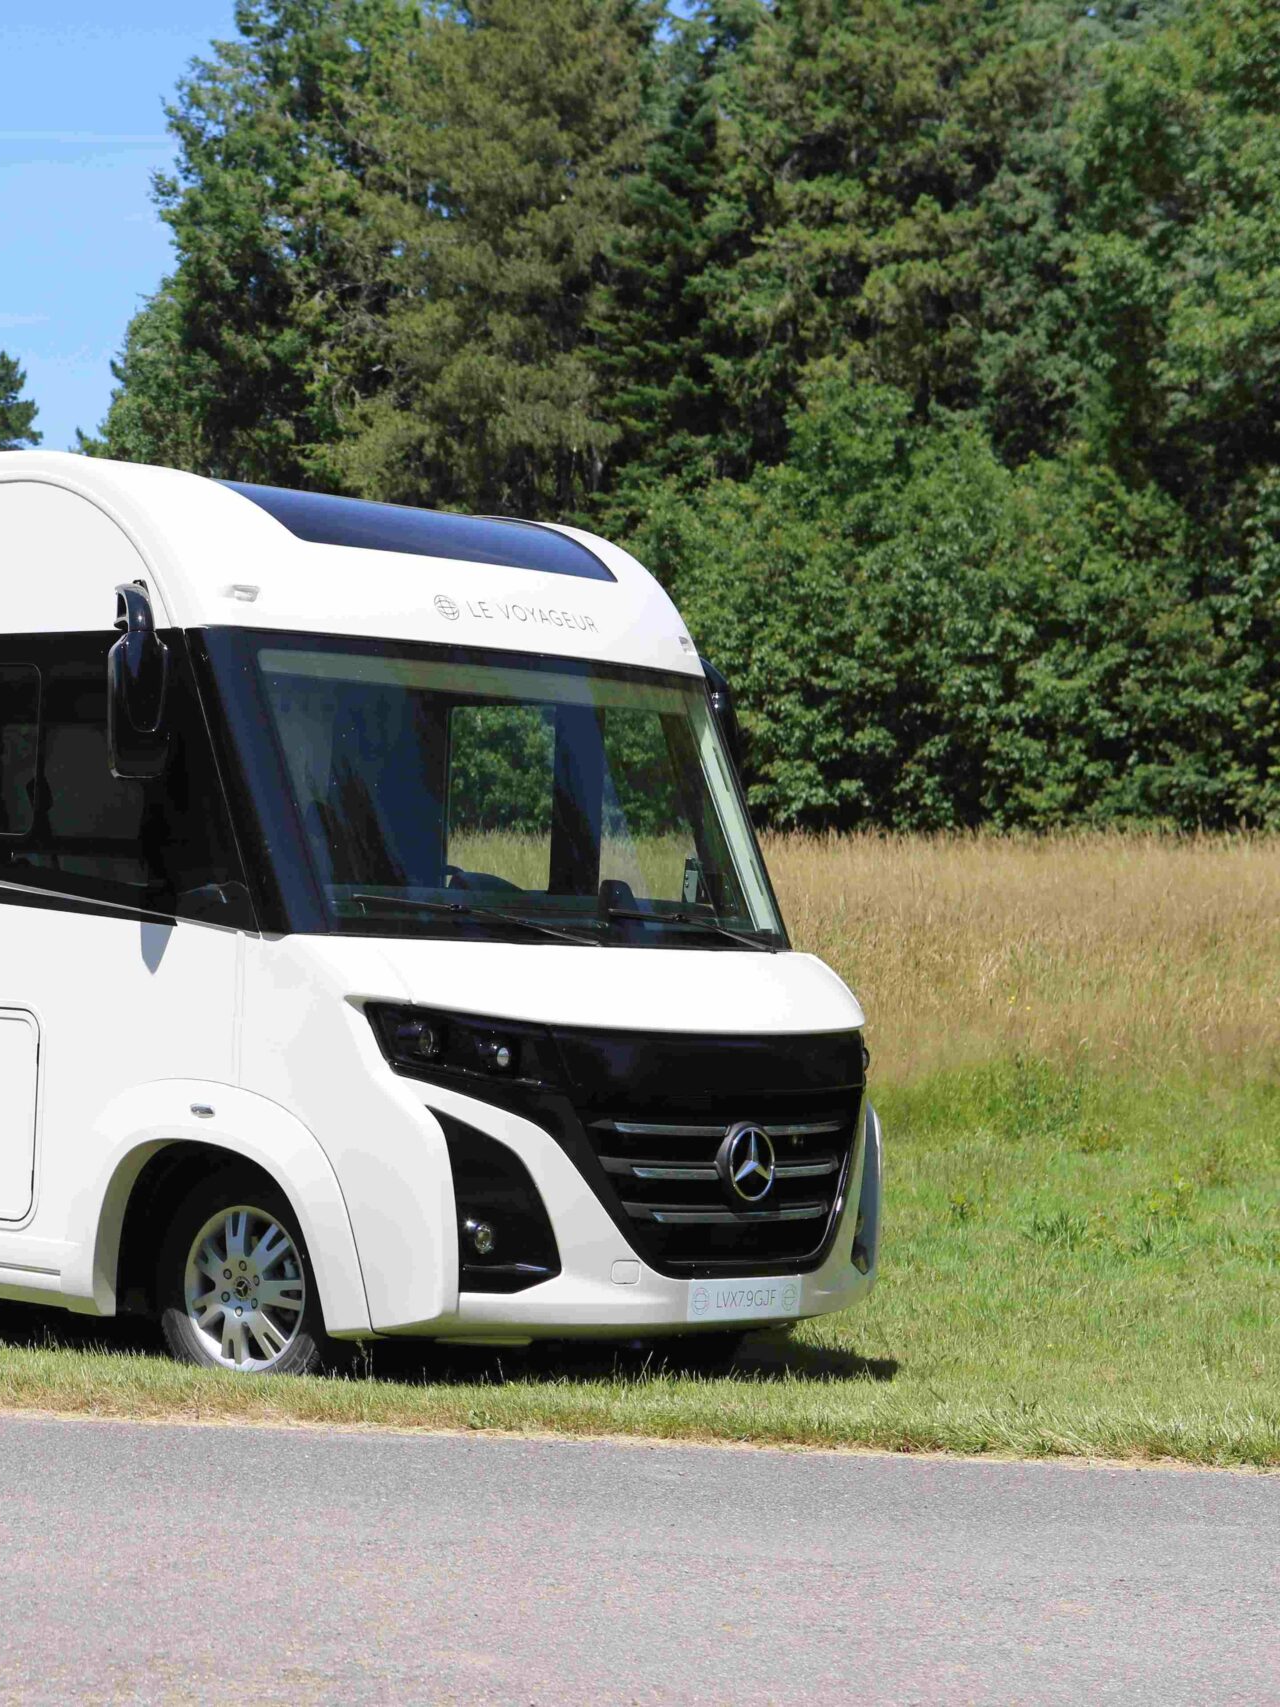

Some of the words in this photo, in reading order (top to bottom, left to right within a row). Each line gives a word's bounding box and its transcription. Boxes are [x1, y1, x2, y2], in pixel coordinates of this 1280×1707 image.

[465, 600, 494, 619] LE
[495, 603, 600, 633] VOYAGEUR
[716, 1289, 777, 1309] LVX7.9GJF
